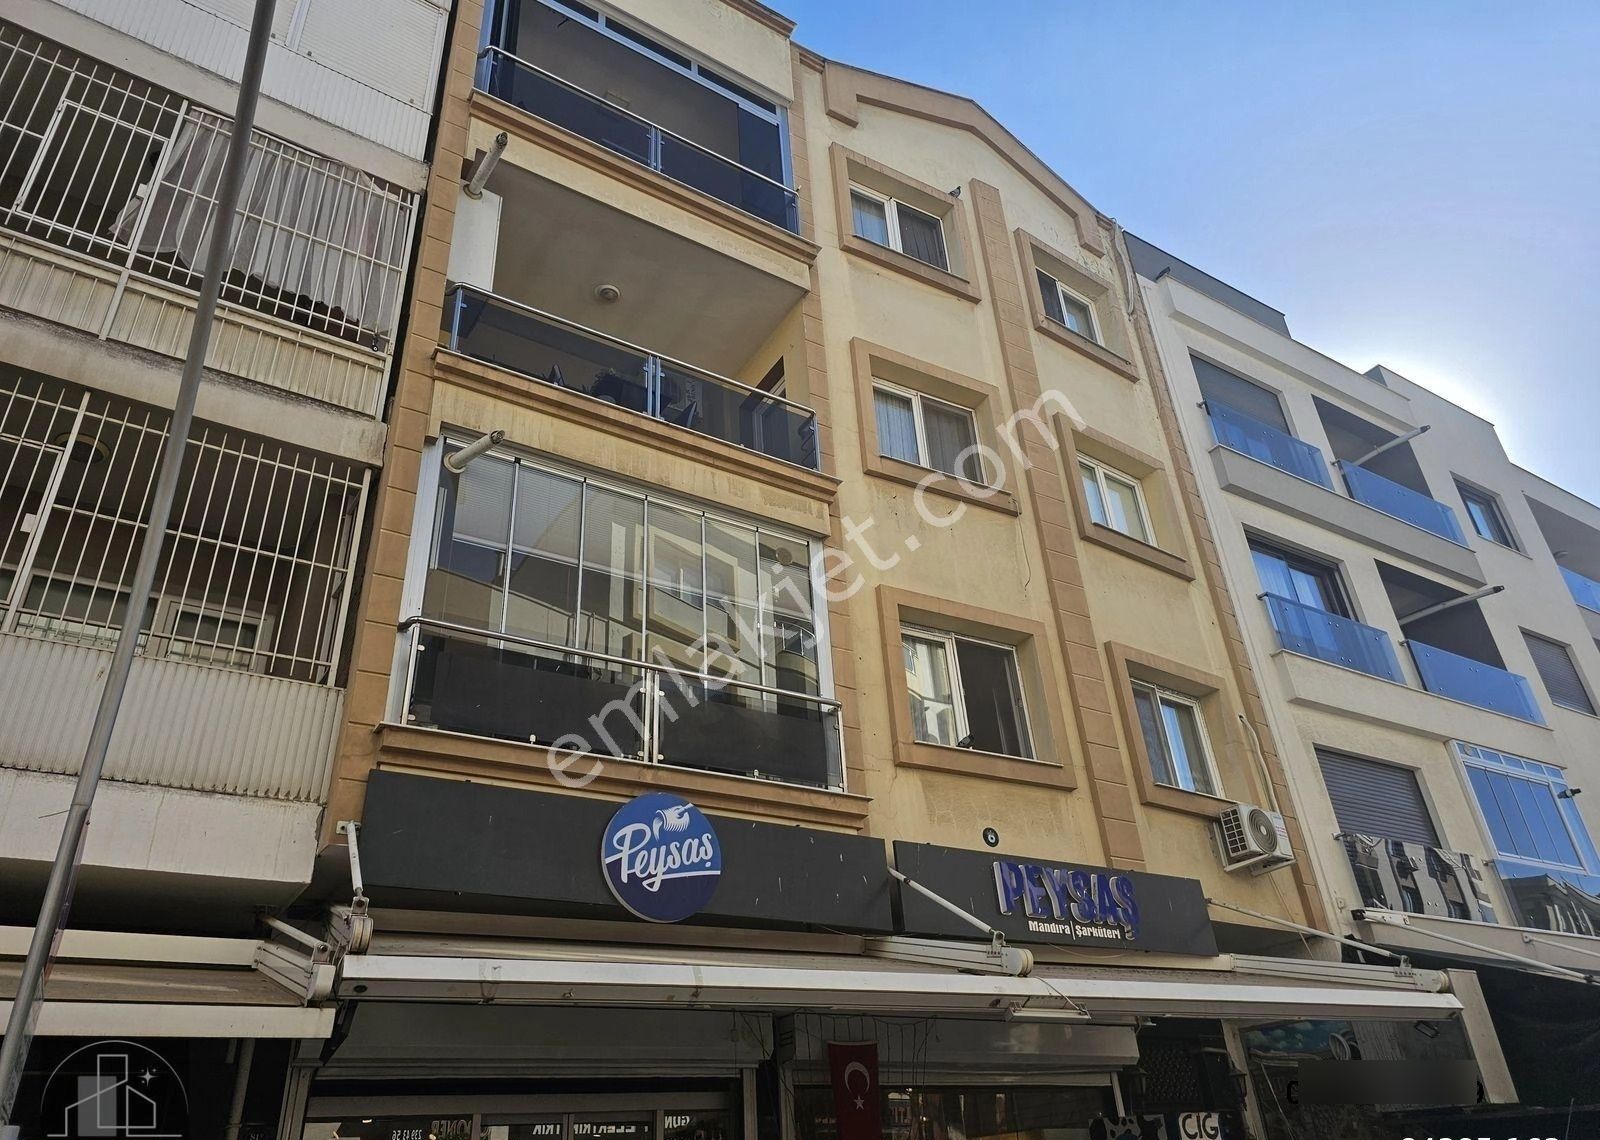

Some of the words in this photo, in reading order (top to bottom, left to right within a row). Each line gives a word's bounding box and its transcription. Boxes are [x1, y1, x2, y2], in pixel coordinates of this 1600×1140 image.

[610, 823, 714, 892] Peysaş
[993, 861, 1140, 940] PEYSAŞ
[1028, 920, 1071, 935] Mandıra
